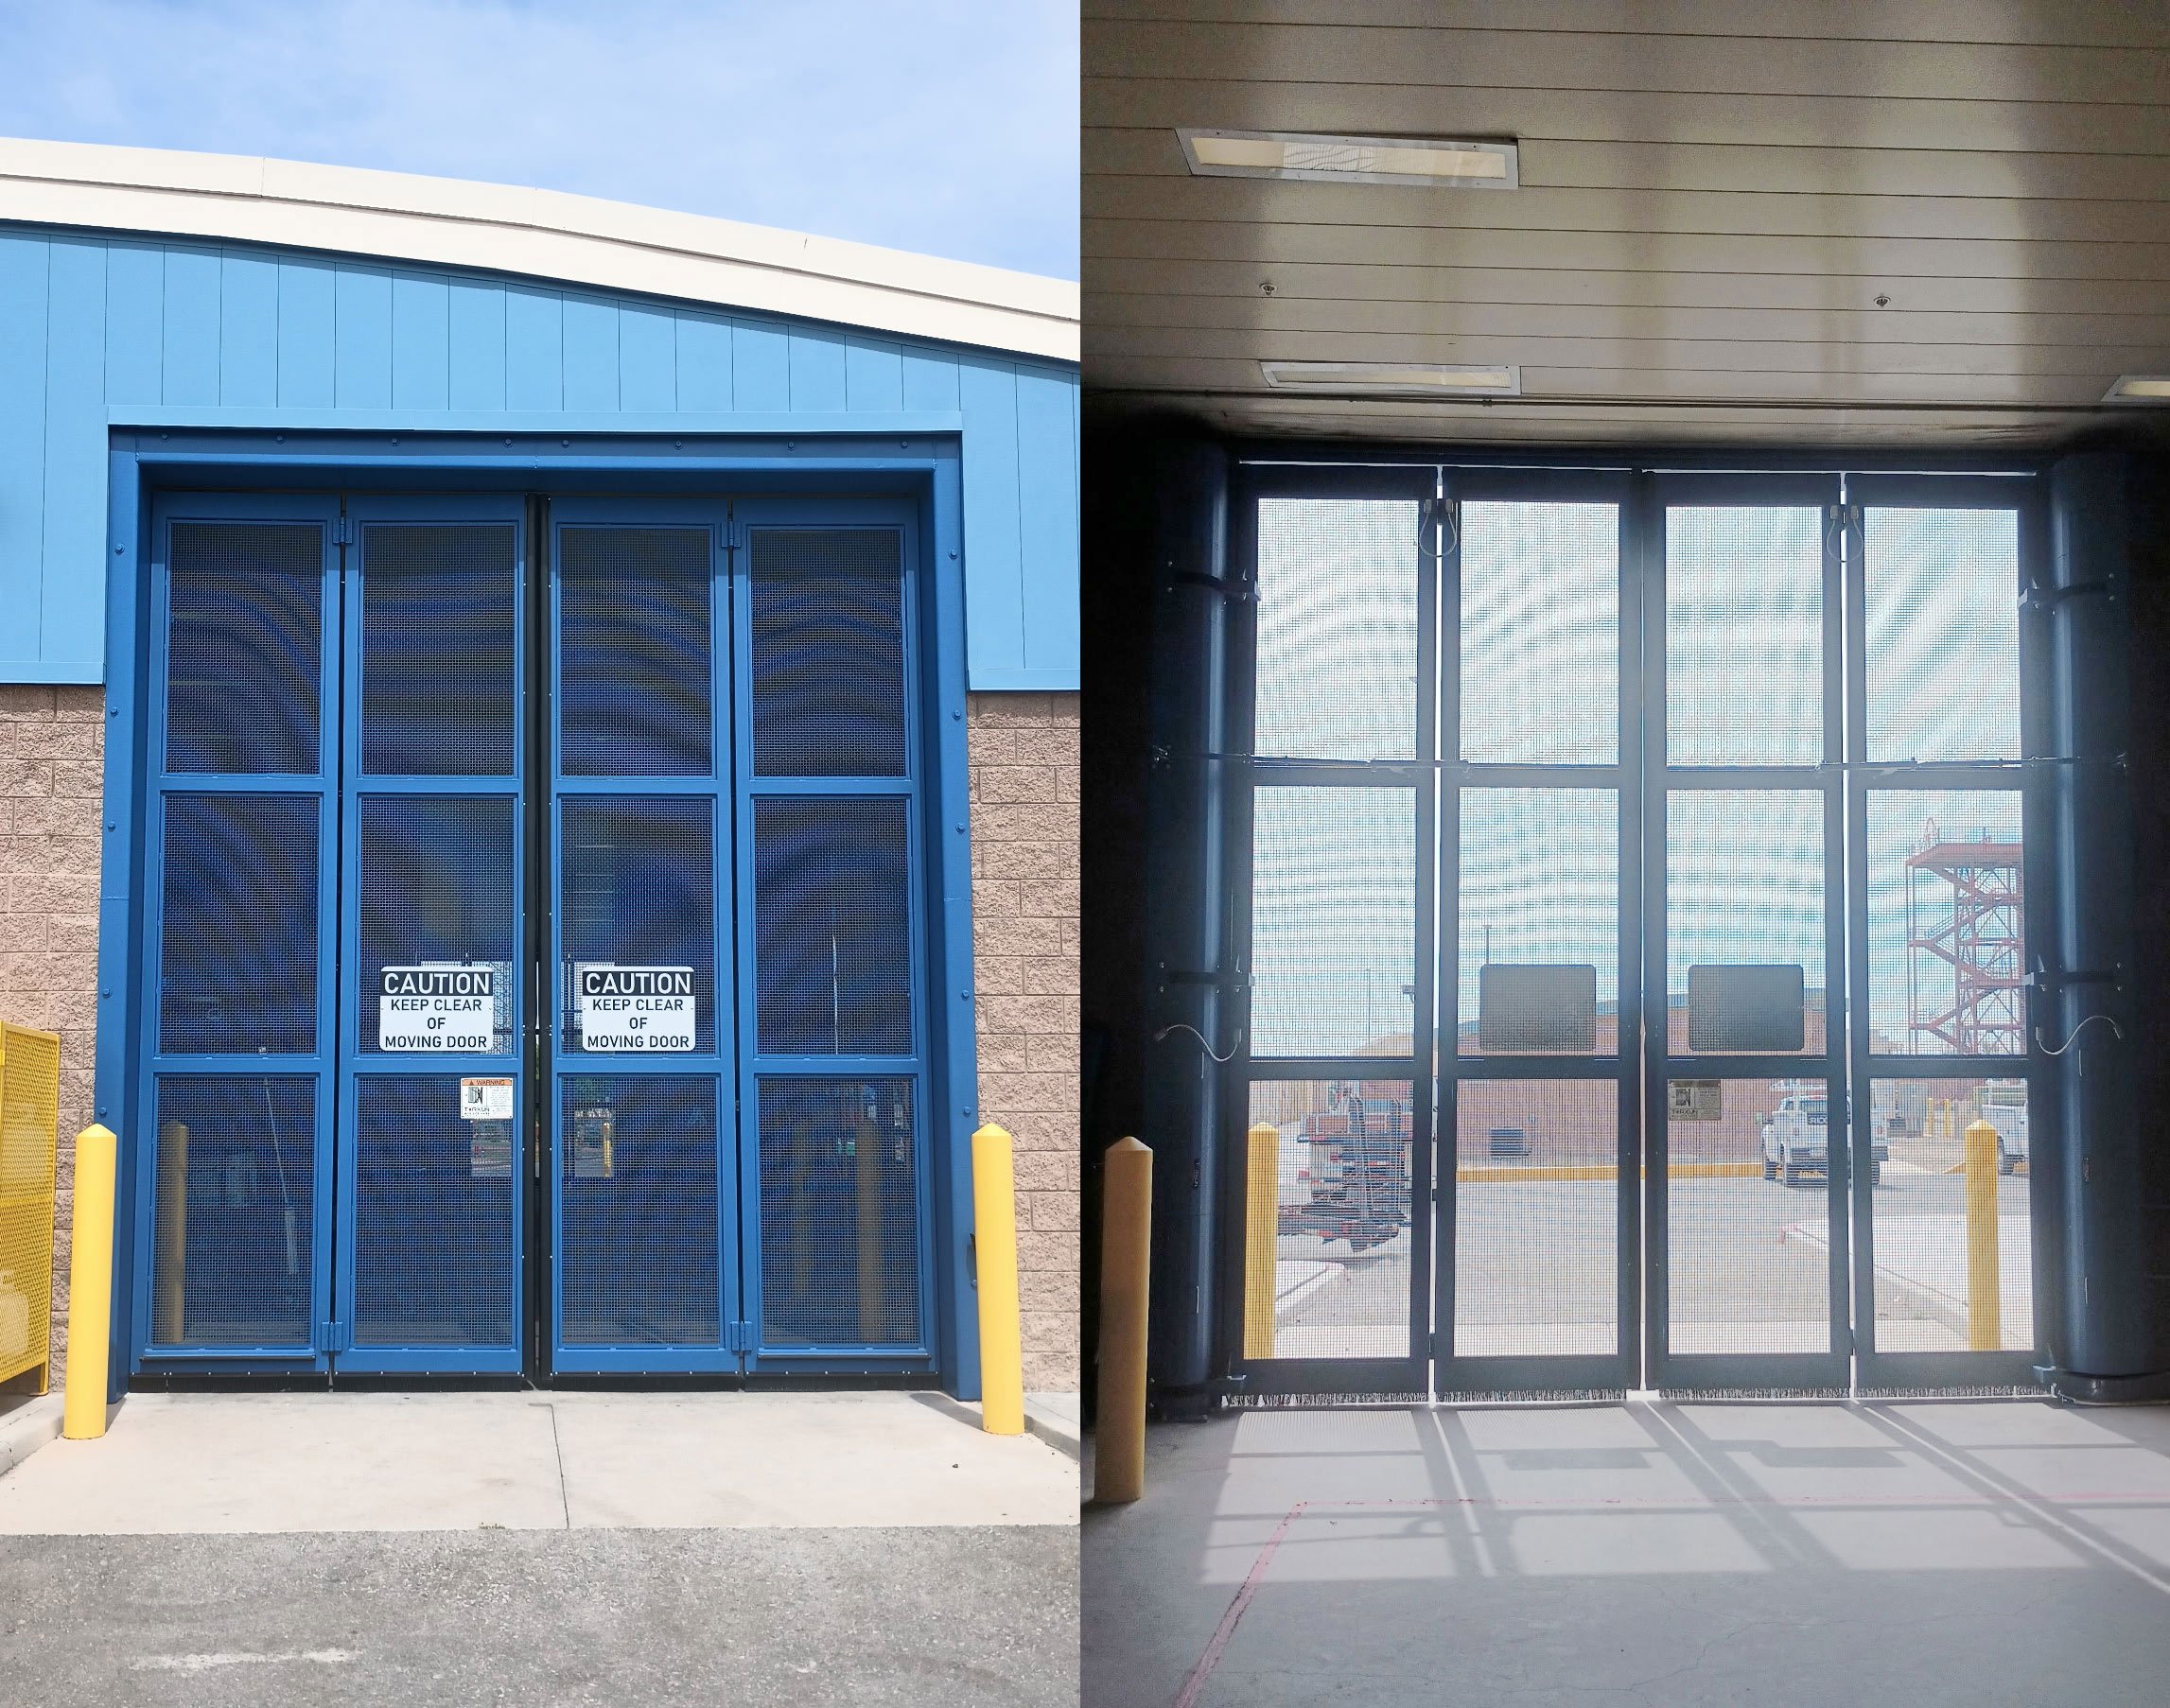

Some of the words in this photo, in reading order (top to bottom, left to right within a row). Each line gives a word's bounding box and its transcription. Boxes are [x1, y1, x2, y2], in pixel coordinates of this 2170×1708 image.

[384, 972, 490, 994] CAUTION
[586, 972, 691, 994] CAUTION
[391, 999, 429, 1011] KEEP
[434, 999, 482, 1011] CLEAR
[592, 999, 631, 1011] KEEP
[636, 999, 684, 1011] CLEAR
[427, 1017, 446, 1030] OF
[629, 1017, 648, 1030] OF
[385, 1036, 442, 1048] MOVING
[446, 1036, 487, 1048] DOOR
[587, 1035, 644, 1048] MOVING
[649, 1035, 690, 1048] DOOR
